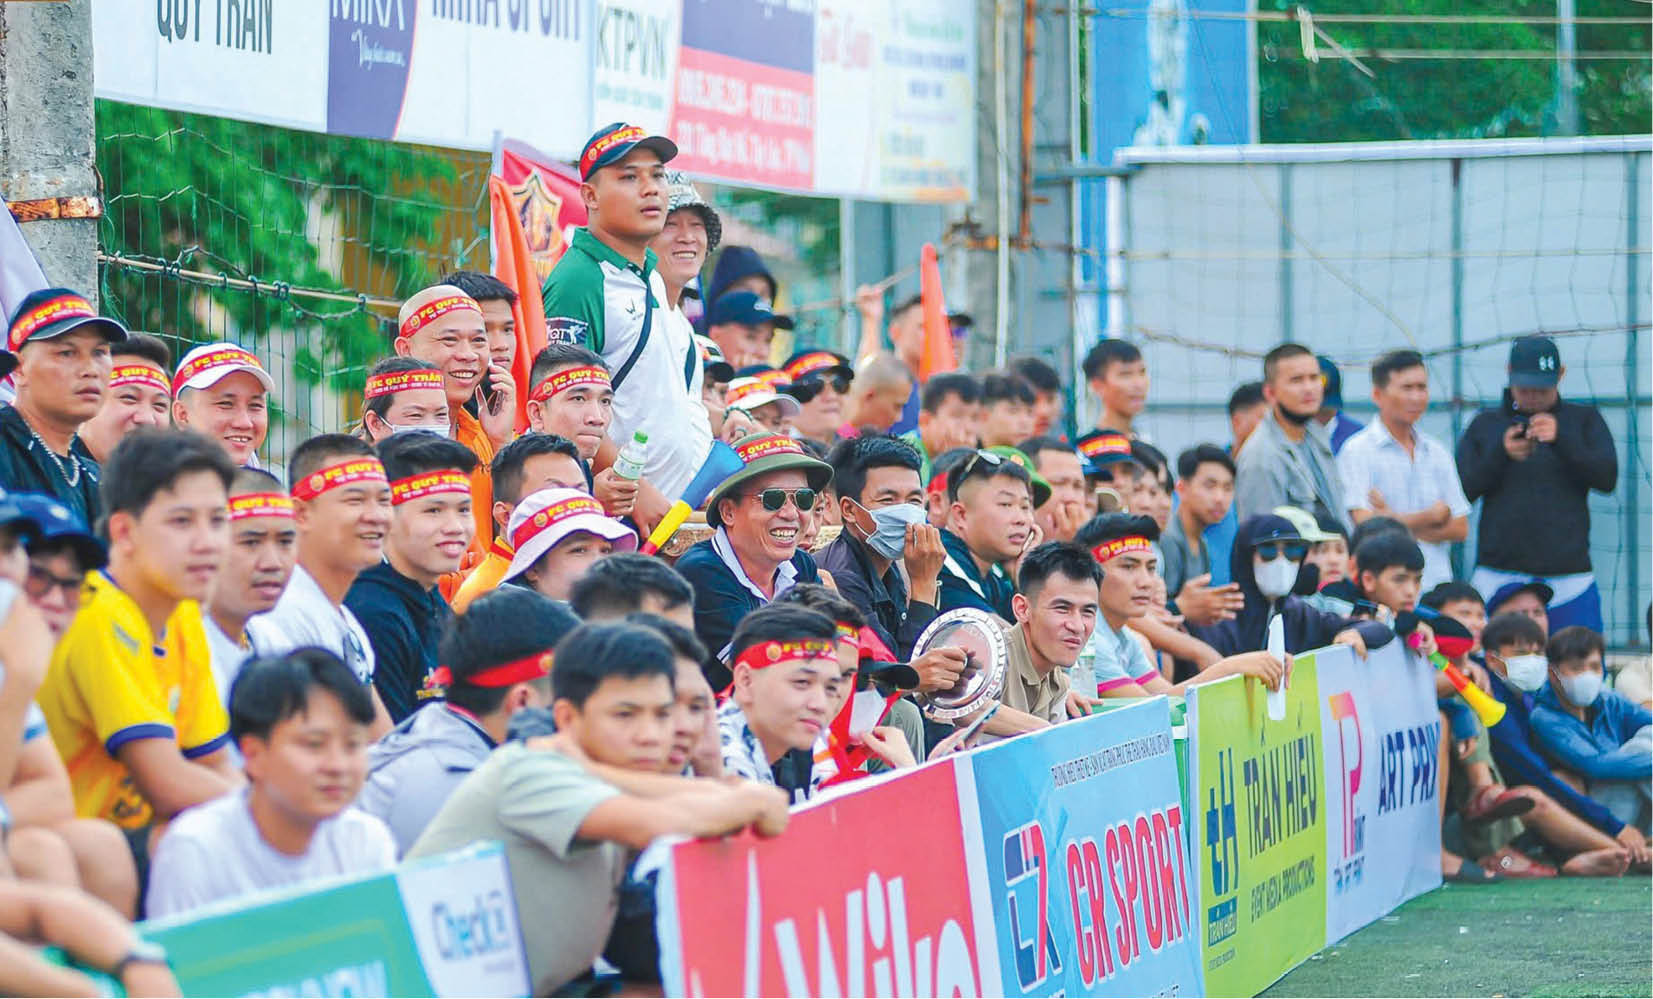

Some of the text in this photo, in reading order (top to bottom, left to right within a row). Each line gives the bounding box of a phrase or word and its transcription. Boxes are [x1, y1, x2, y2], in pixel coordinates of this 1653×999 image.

[1378, 731, 1405, 816] ART
[1067, 806, 1191, 985] CR SPORT
